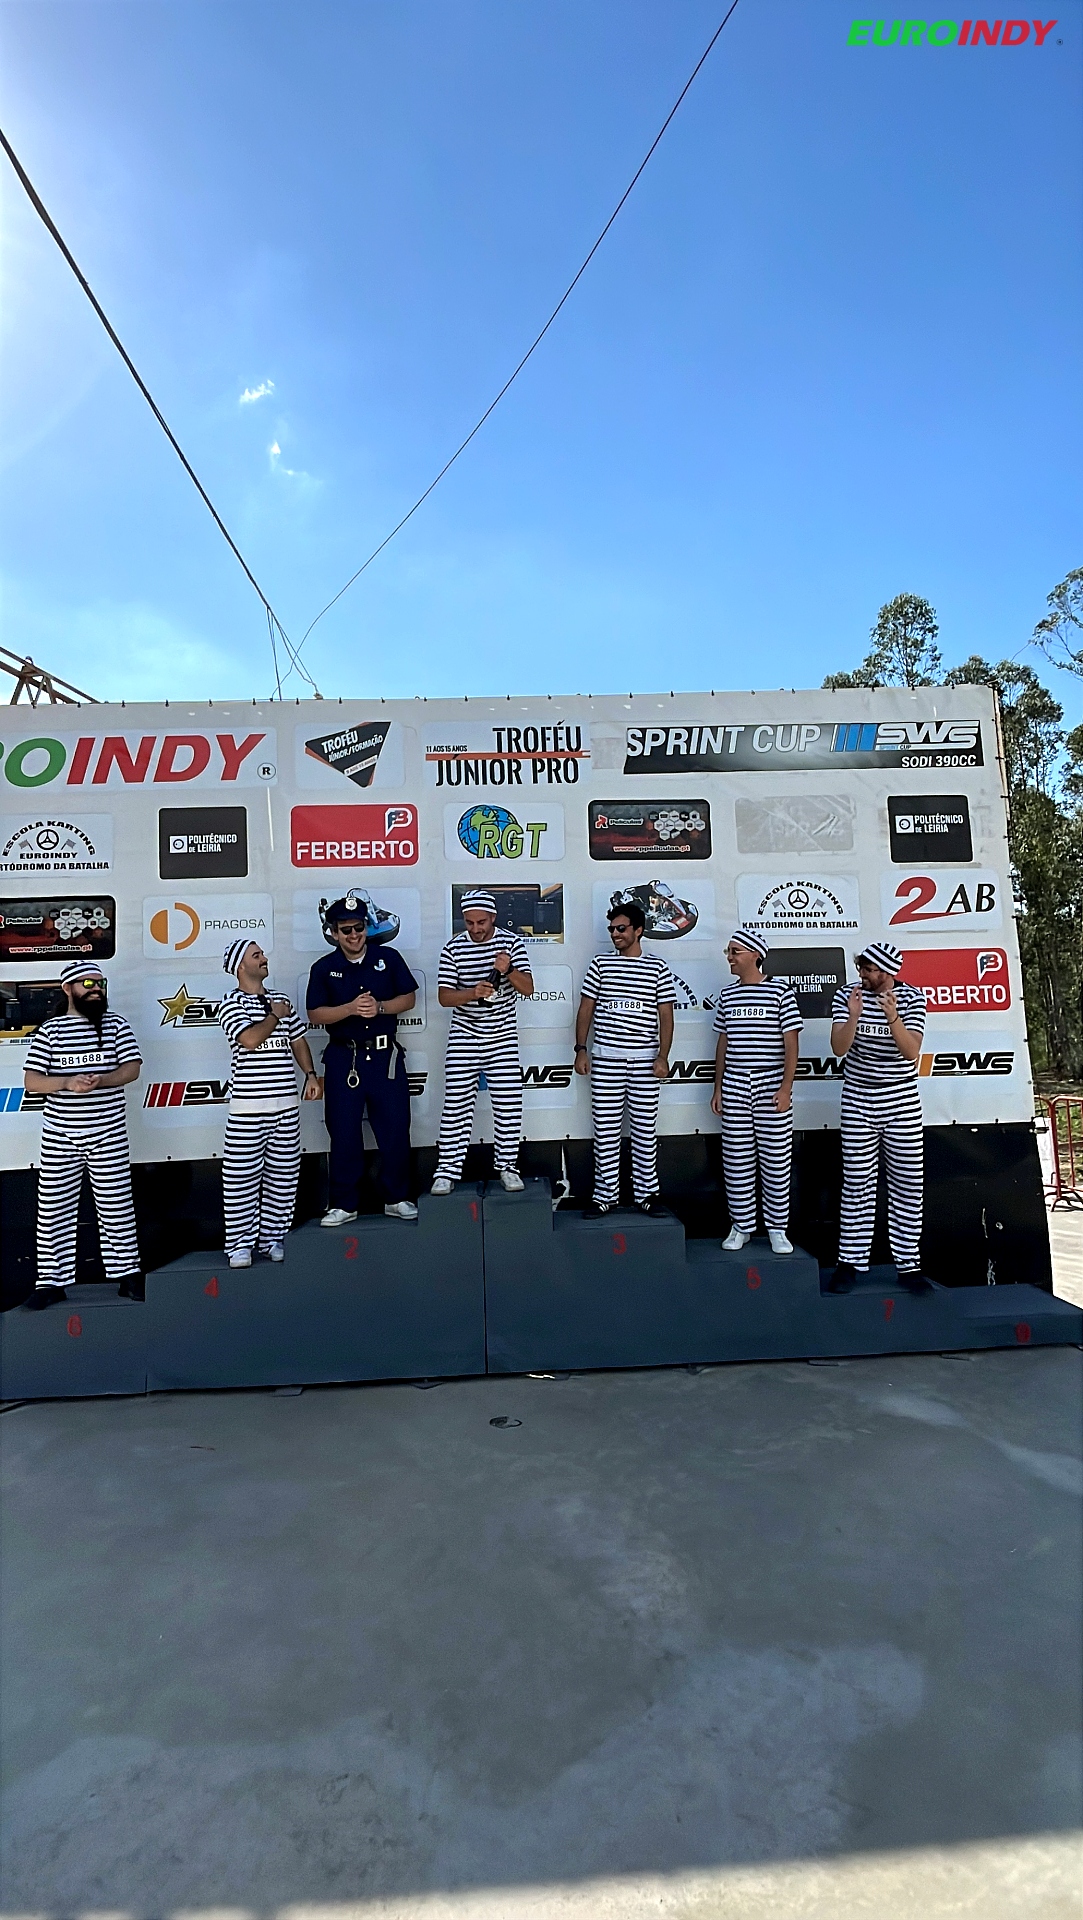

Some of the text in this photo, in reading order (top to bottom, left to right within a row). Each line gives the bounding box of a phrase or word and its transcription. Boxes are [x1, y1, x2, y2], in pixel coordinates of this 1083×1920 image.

[321, 728, 359, 754] TROFÉU
[492, 720, 582, 753] TROFÉU
[627, 725, 822, 757] SPRINT CUP
[877, 721, 980, 749] SWS
[426, 745, 432, 753] 11
[451, 744, 468, 753] ANOS
[0, 734, 267, 788] OINDY
[436, 753, 579, 787] JÚNIOR PRO
[901, 754, 977, 768] SODI 390CC
[913, 813, 964, 825] POLITÉCNICO
[924, 824, 949, 833] LEIRIA
[2, 820, 96, 857] ESCOLA KARTING
[188, 832, 238, 845] POLITÉCNICO
[197, 843, 222, 853] LEIRIA
[477, 822, 548, 859] RGT
[19, 852, 78, 860] EUROINDY
[296, 840, 414, 861] FERBERTO
[0, 862, 51, 871] RTÓDROMO
[68, 862, 110, 870] BATALHA
[757, 880, 844, 916] ESCOLA KARTING
[204, 918, 266, 930] PRAGOSA
[742, 920, 859, 929] KARTÓDROMO DA BATALHA
[672, 973, 698, 1007] TING
[790, 974, 837, 985] POLITÉCNICO
[799, 984, 823, 993] LEIRIA
[515, 991, 566, 1001] RAGOSA
[917, 984, 1007, 1005] RBERTO
[732, 1008, 764, 1017] 881688
[860, 1024, 892, 1036] 88168
[61, 1053, 102, 1066] 881688
[932, 1051, 1015, 1076] SWS
[521, 1065, 574, 1087] WS
[469, 1201, 479, 1222] 1
[344, 1237, 359, 1259] 2
[611, 1233, 627, 1255] 3
[203, 1276, 219, 1298] 4
[882, 1298, 895, 1321] 7
